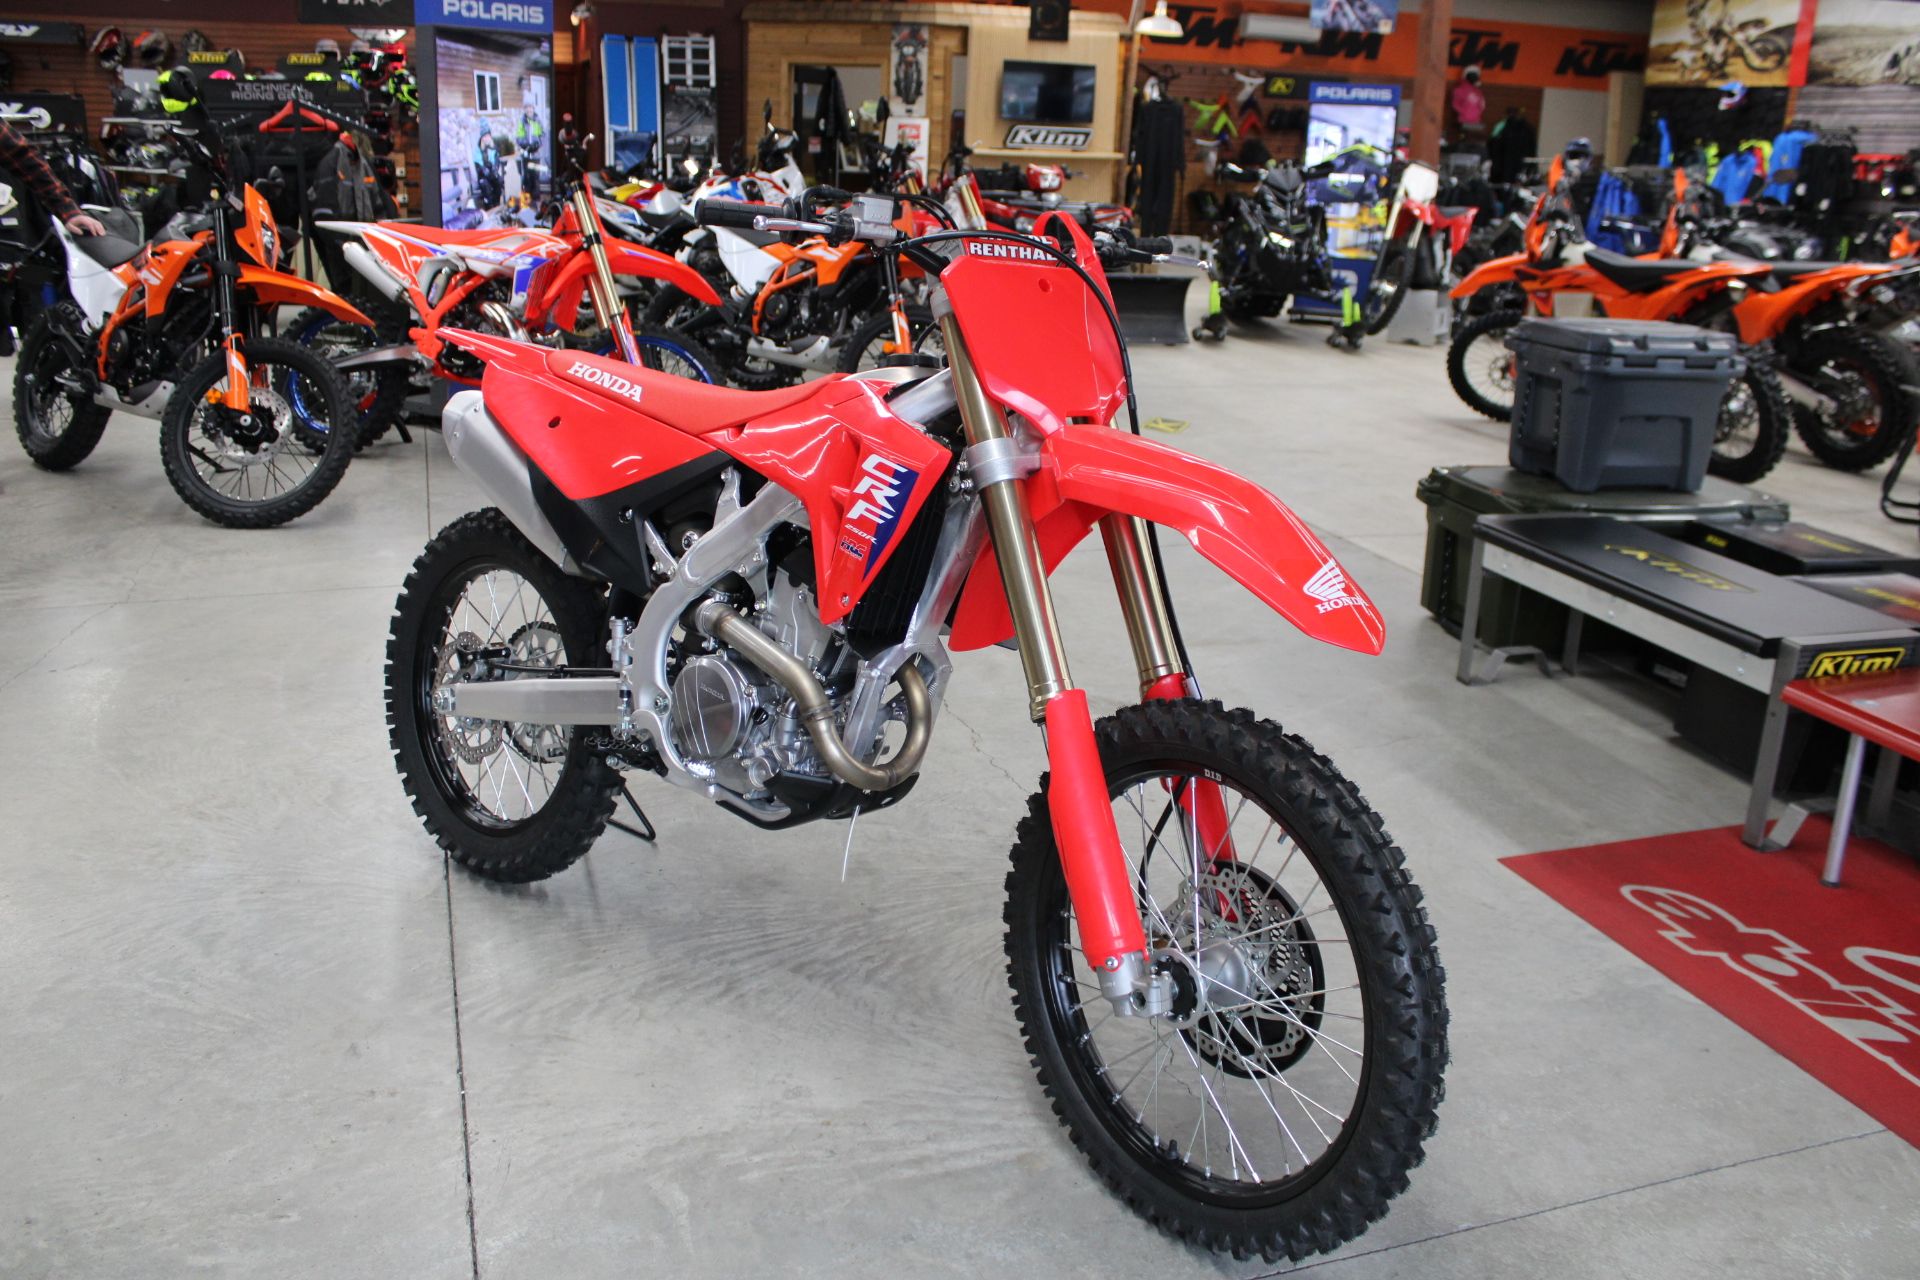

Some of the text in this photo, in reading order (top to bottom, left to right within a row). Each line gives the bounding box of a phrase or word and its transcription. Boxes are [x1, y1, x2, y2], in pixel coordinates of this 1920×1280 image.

[442, 0, 545, 25] POLARIS
[231, 91, 274, 100] RIDING
[236, 82, 304, 92] TECHNICA
[1316, 86, 1392, 100] POLARIS
[1013, 128, 1087, 146] Klim
[969, 242, 1057, 261] RENTHAL
[567, 361, 643, 403] HONDA
[846, 453, 909, 524] CRF
[844, 523, 878, 545] 250R
[1815, 655, 1896, 677] Klim
